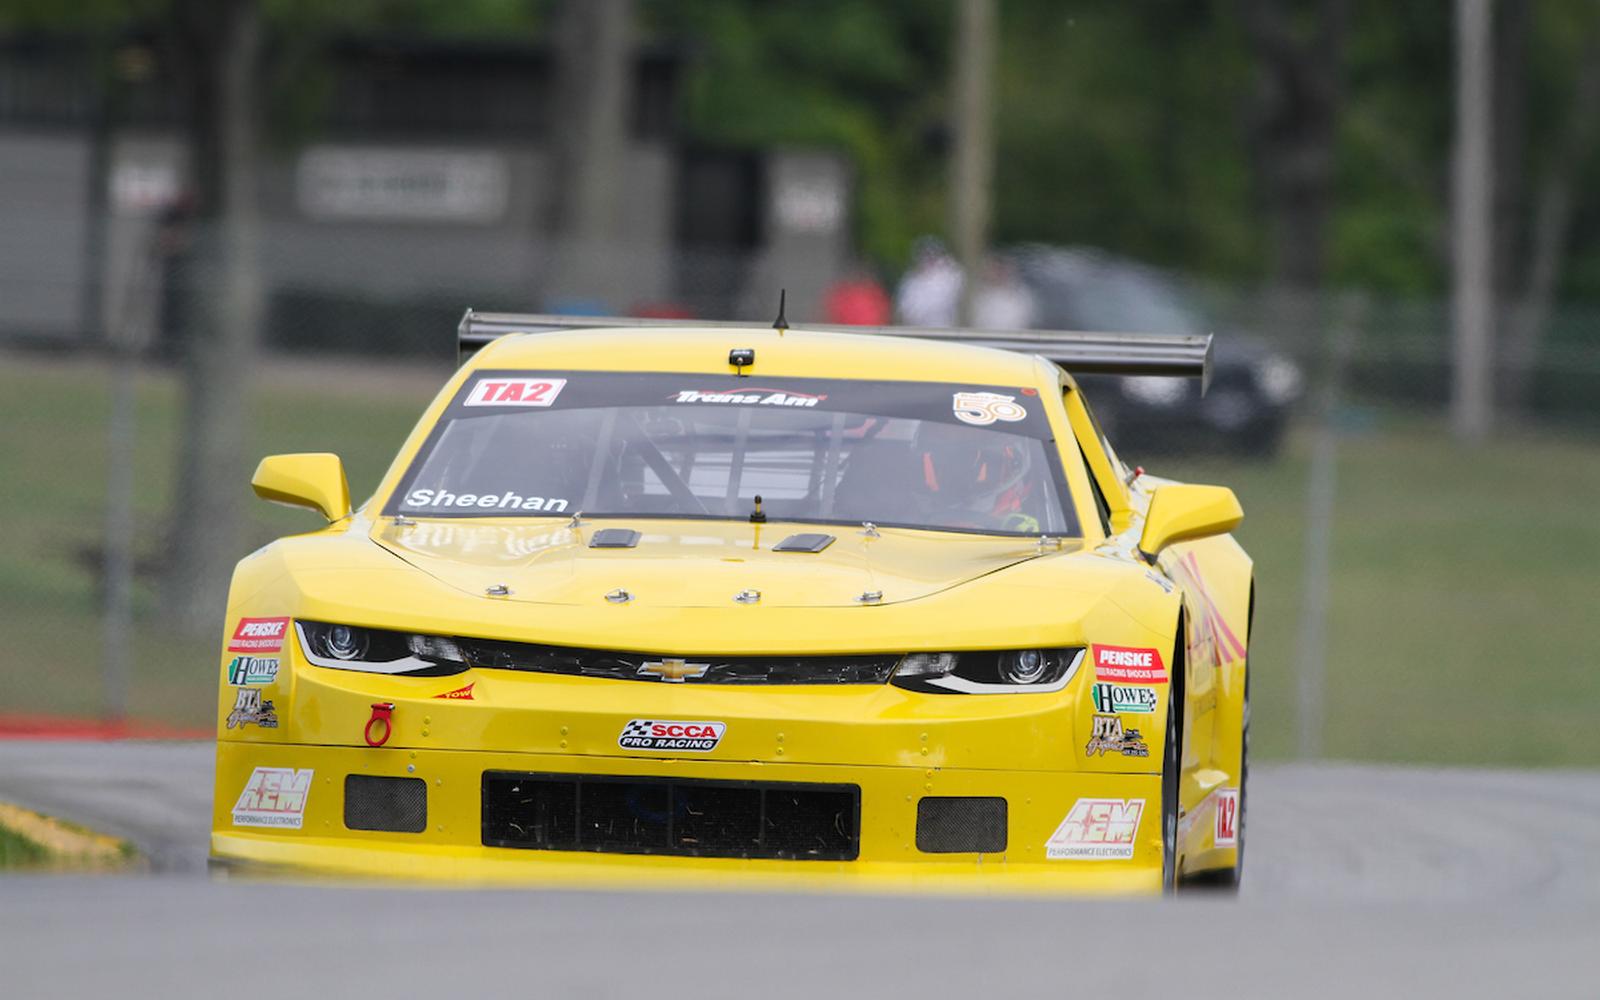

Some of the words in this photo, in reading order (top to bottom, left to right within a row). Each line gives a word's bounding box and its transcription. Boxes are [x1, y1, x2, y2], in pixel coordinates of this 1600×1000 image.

[481, 382, 553, 402] TA2
[676, 390, 764, 404] Trans
[760, 393, 819, 407] Am
[953, 398, 1027, 425] 50
[406, 488, 569, 513] Sheehan
[240, 622, 285, 637] PENSKE
[1100, 650, 1153, 667] PENSKE
[230, 656, 275, 685] HOWE
[1106, 668, 1127, 678] RACING
[1126, 669, 1152, 679] SHOCKS
[234, 688, 262, 710] BTA
[445, 689, 471, 699] TOW
[1096, 683, 1150, 713] HOWE
[651, 724, 717, 738] SCCA
[1092, 715, 1123, 738] BTA
[621, 737, 652, 747] PRO
[655, 739, 714, 749] RACING
[234, 768, 312, 814] AEM
[235, 814, 268, 825] PERFORMANCE
[268, 815, 302, 827] ELECTRONICS
[1050, 801, 1143, 845] AEM
[1217, 796, 1235, 839] TA2
[1048, 847, 1095, 857] PERFORMANCE
[1095, 847, 1132, 857] ELECTRONICS
